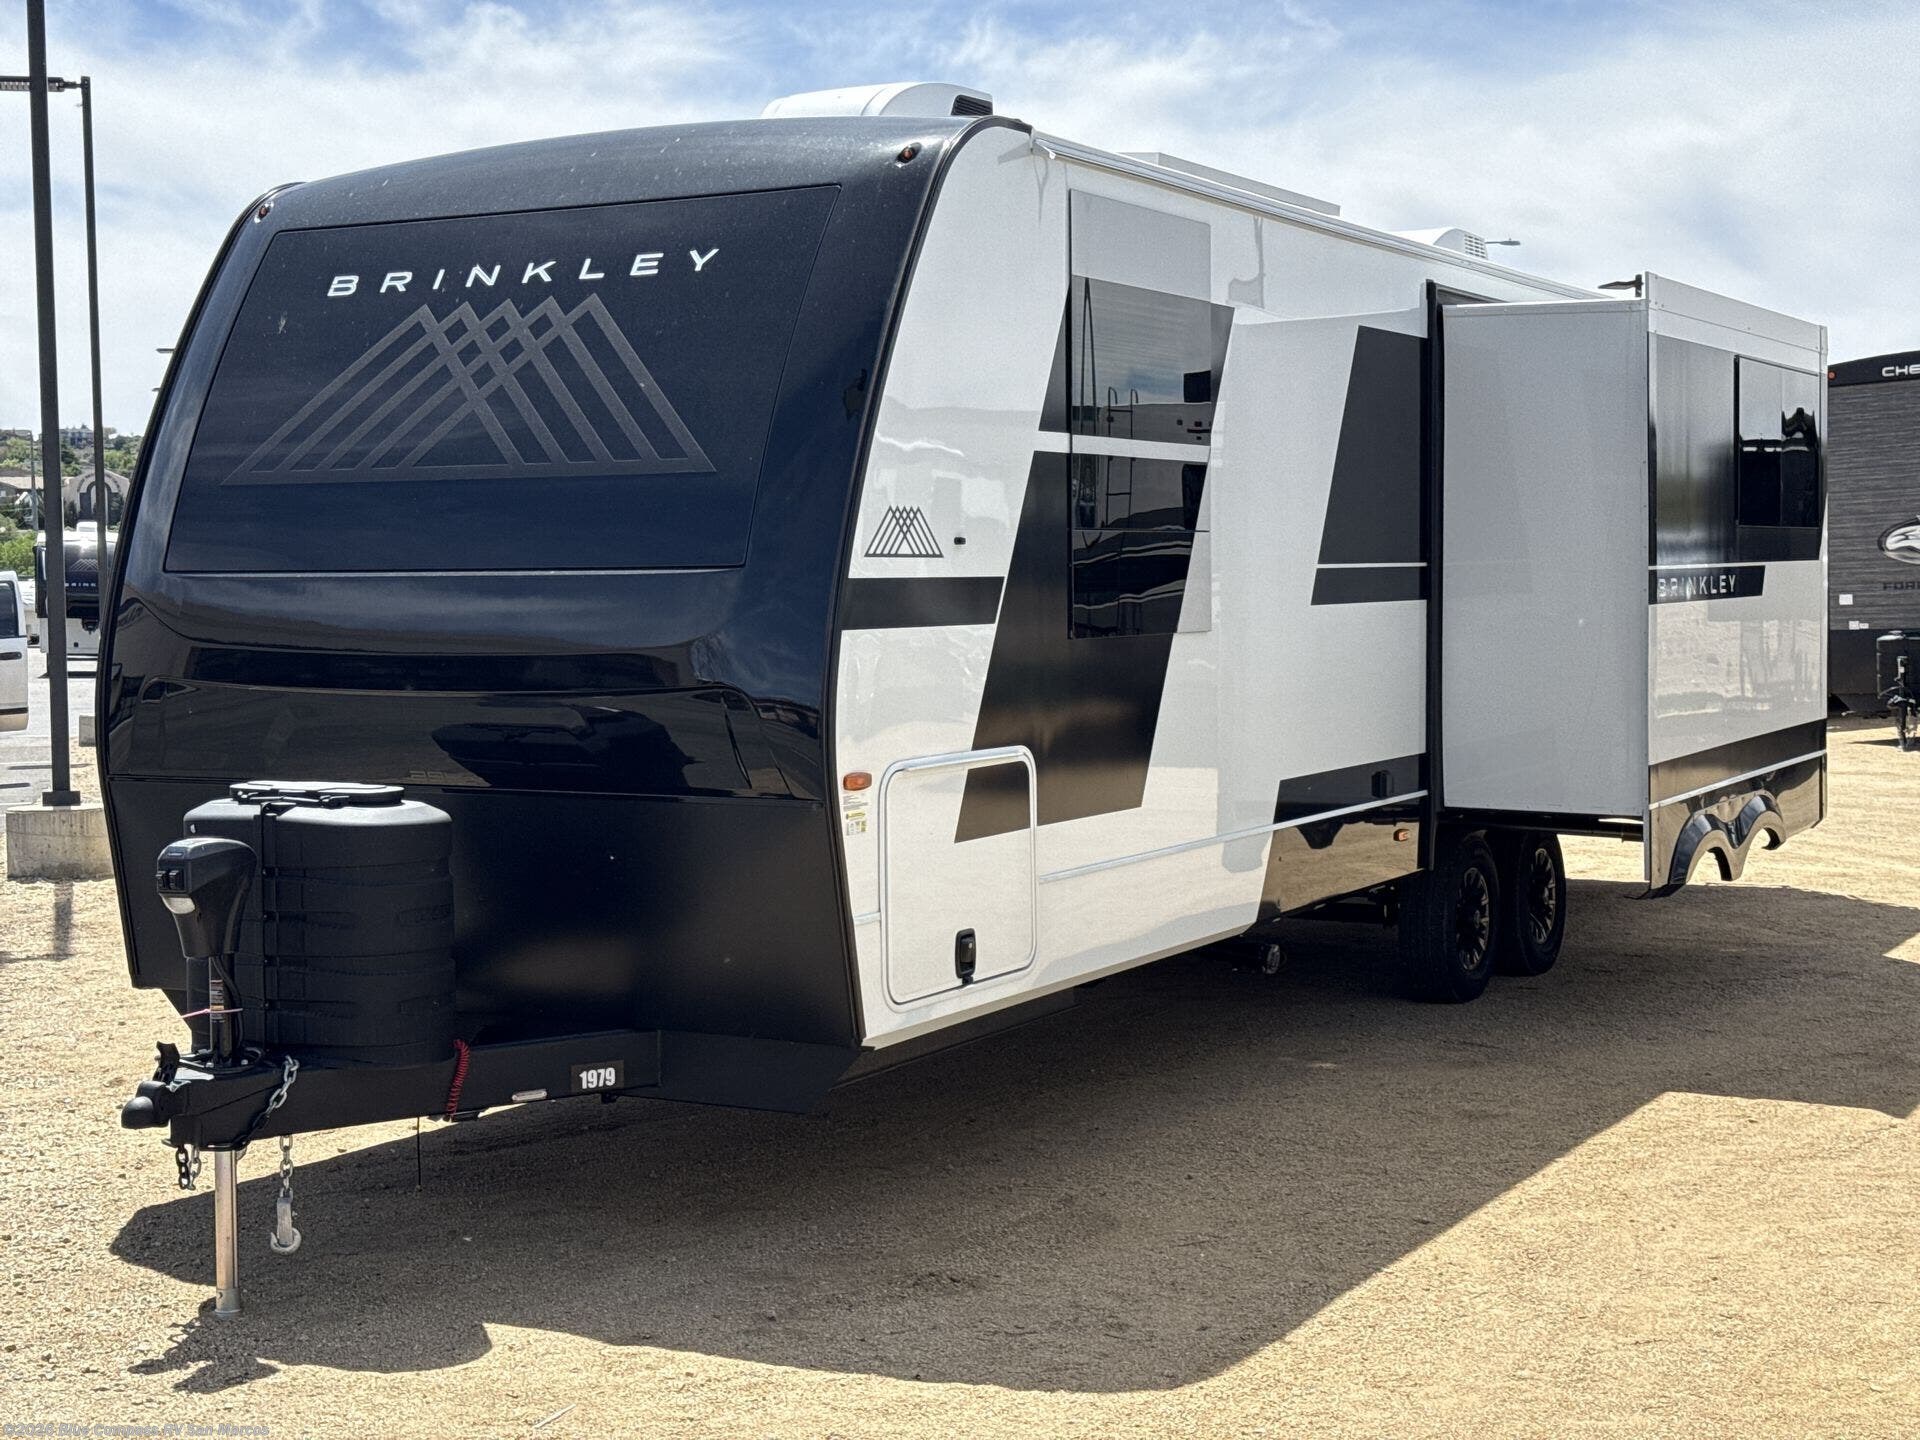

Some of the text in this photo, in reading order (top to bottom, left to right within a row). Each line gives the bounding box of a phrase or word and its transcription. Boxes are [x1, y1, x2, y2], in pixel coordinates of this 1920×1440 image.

[327, 248, 719, 297] BRINKLEY
[1881, 364, 1920, 377] CHE
[1658, 575, 1736, 598] BRINKLEY
[1883, 581, 1920, 590] FOR
[579, 1067, 616, 1090] 1979
